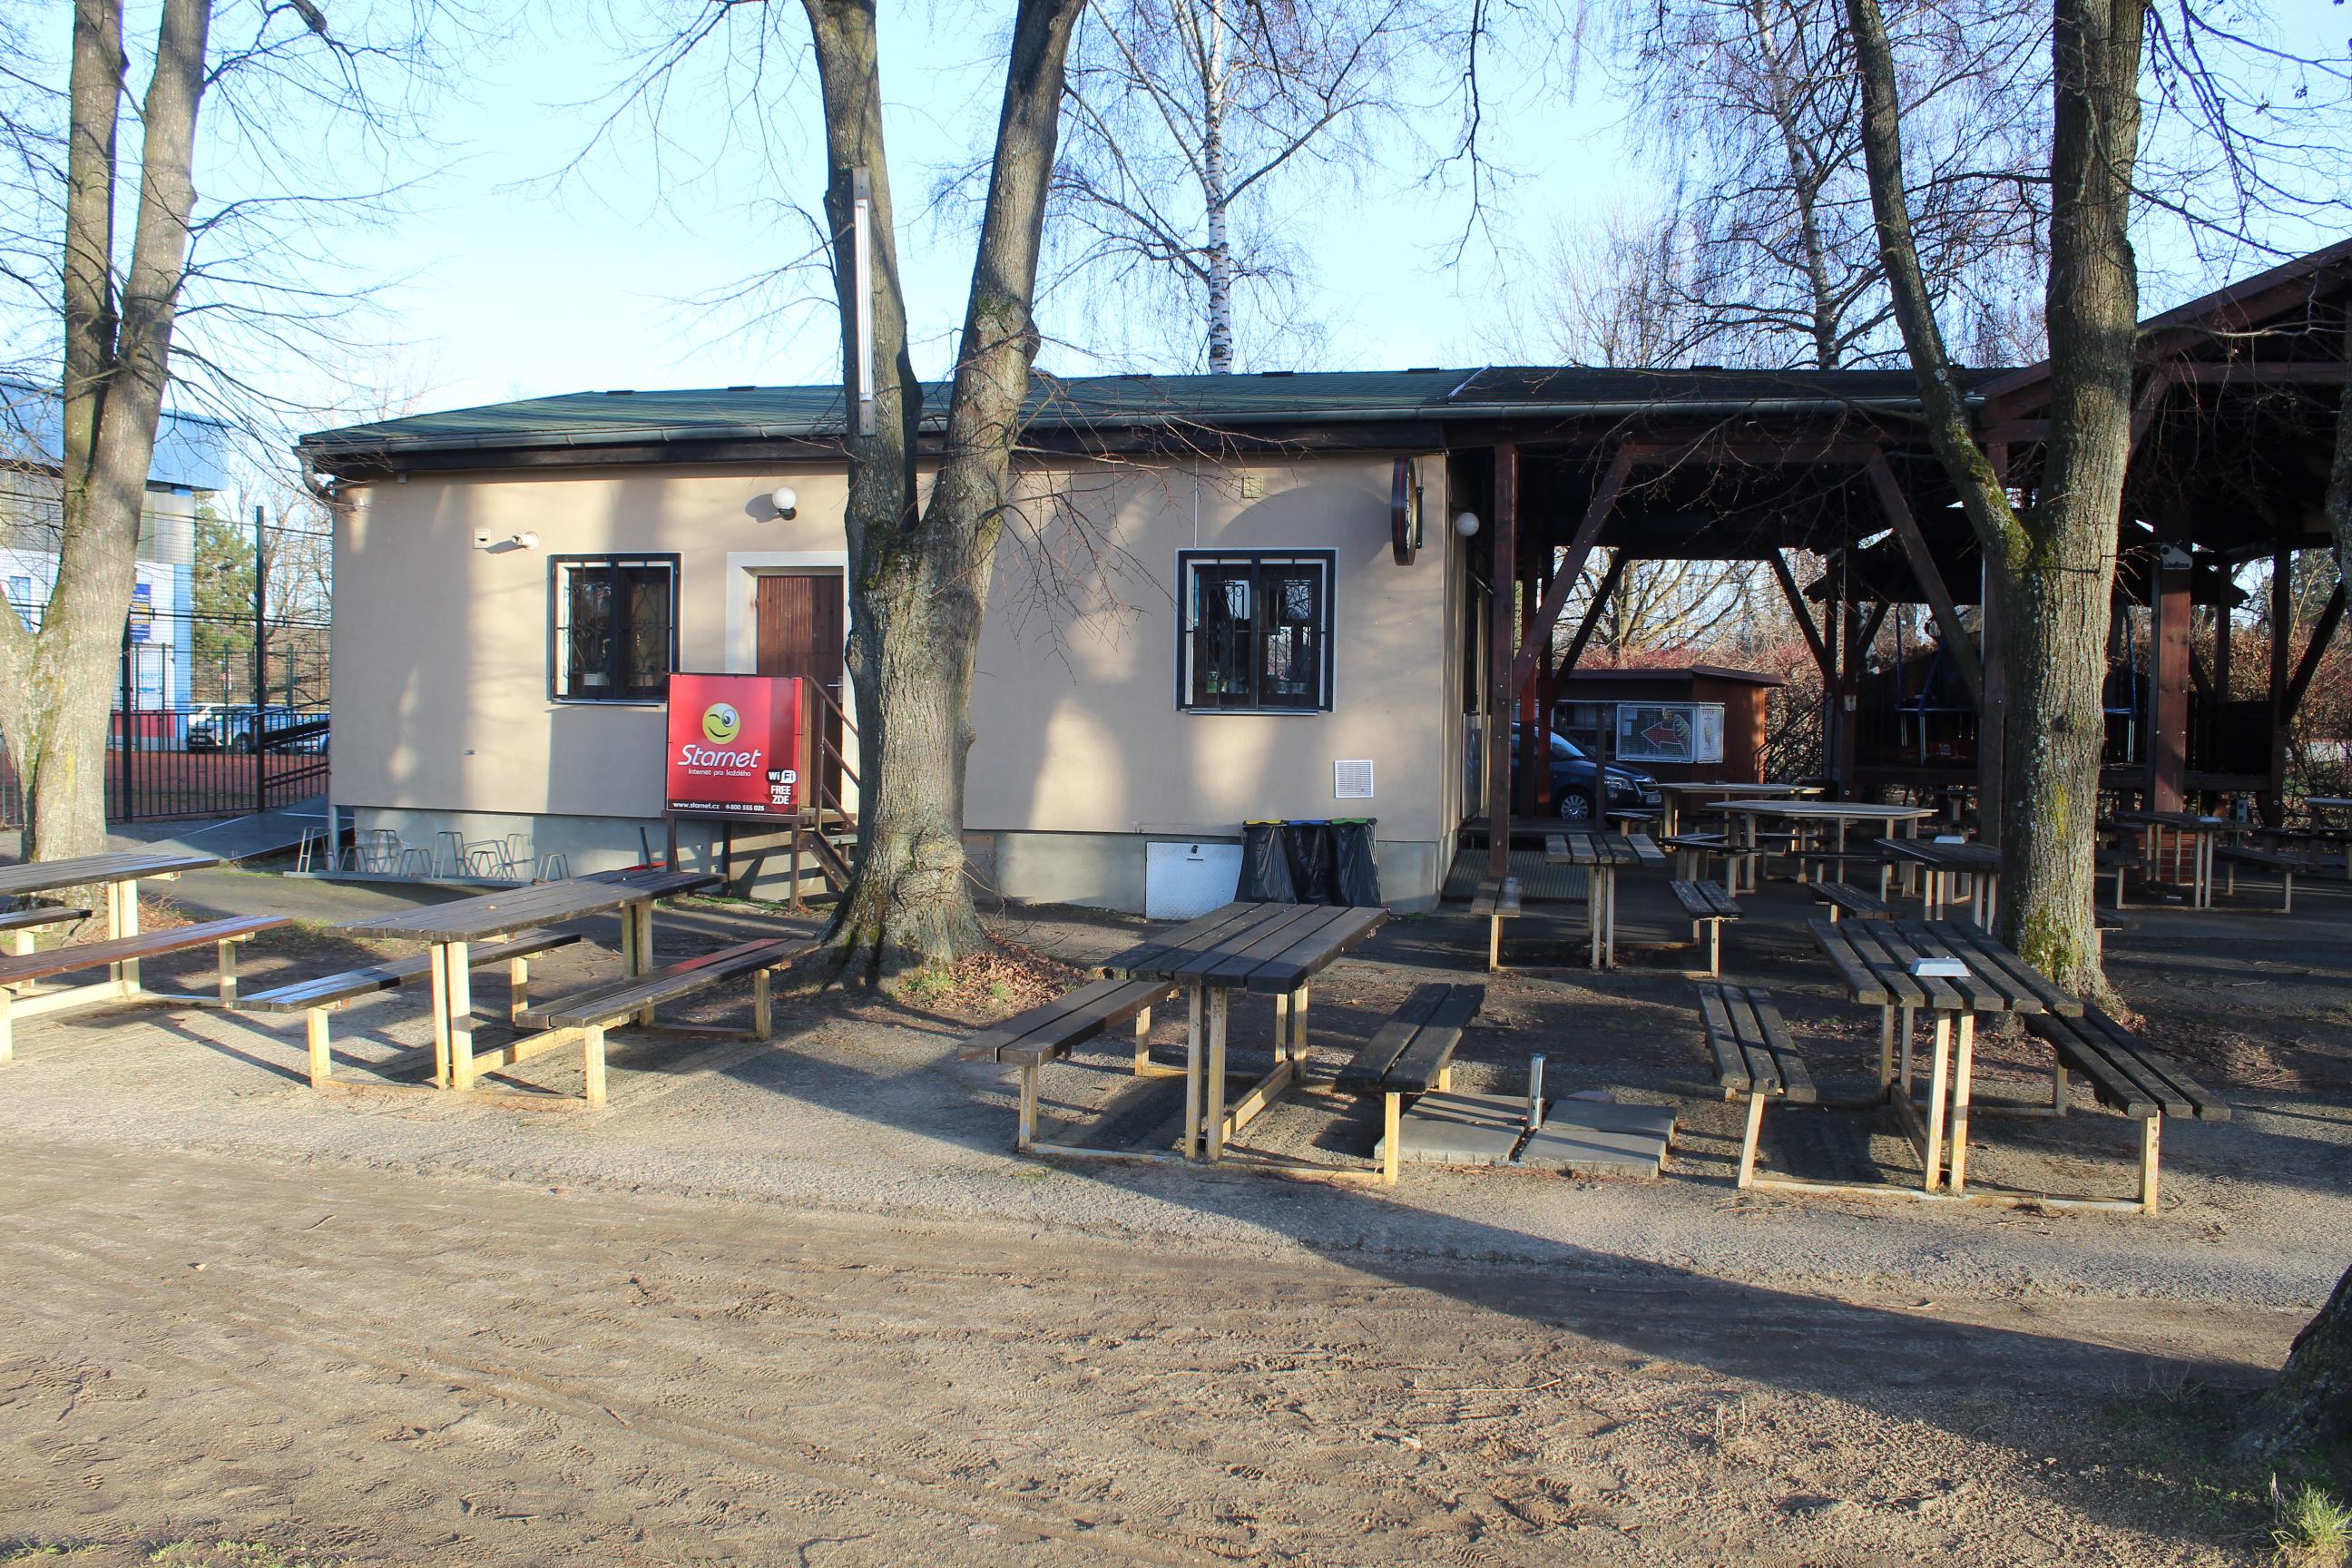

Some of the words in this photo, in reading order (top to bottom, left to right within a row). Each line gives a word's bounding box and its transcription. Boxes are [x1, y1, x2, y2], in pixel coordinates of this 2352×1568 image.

[678, 744, 761, 768] Starnet
[688, 768, 712, 776] Internet
[770, 785, 791, 795] FREE
[771, 795, 789, 805] ZDE
